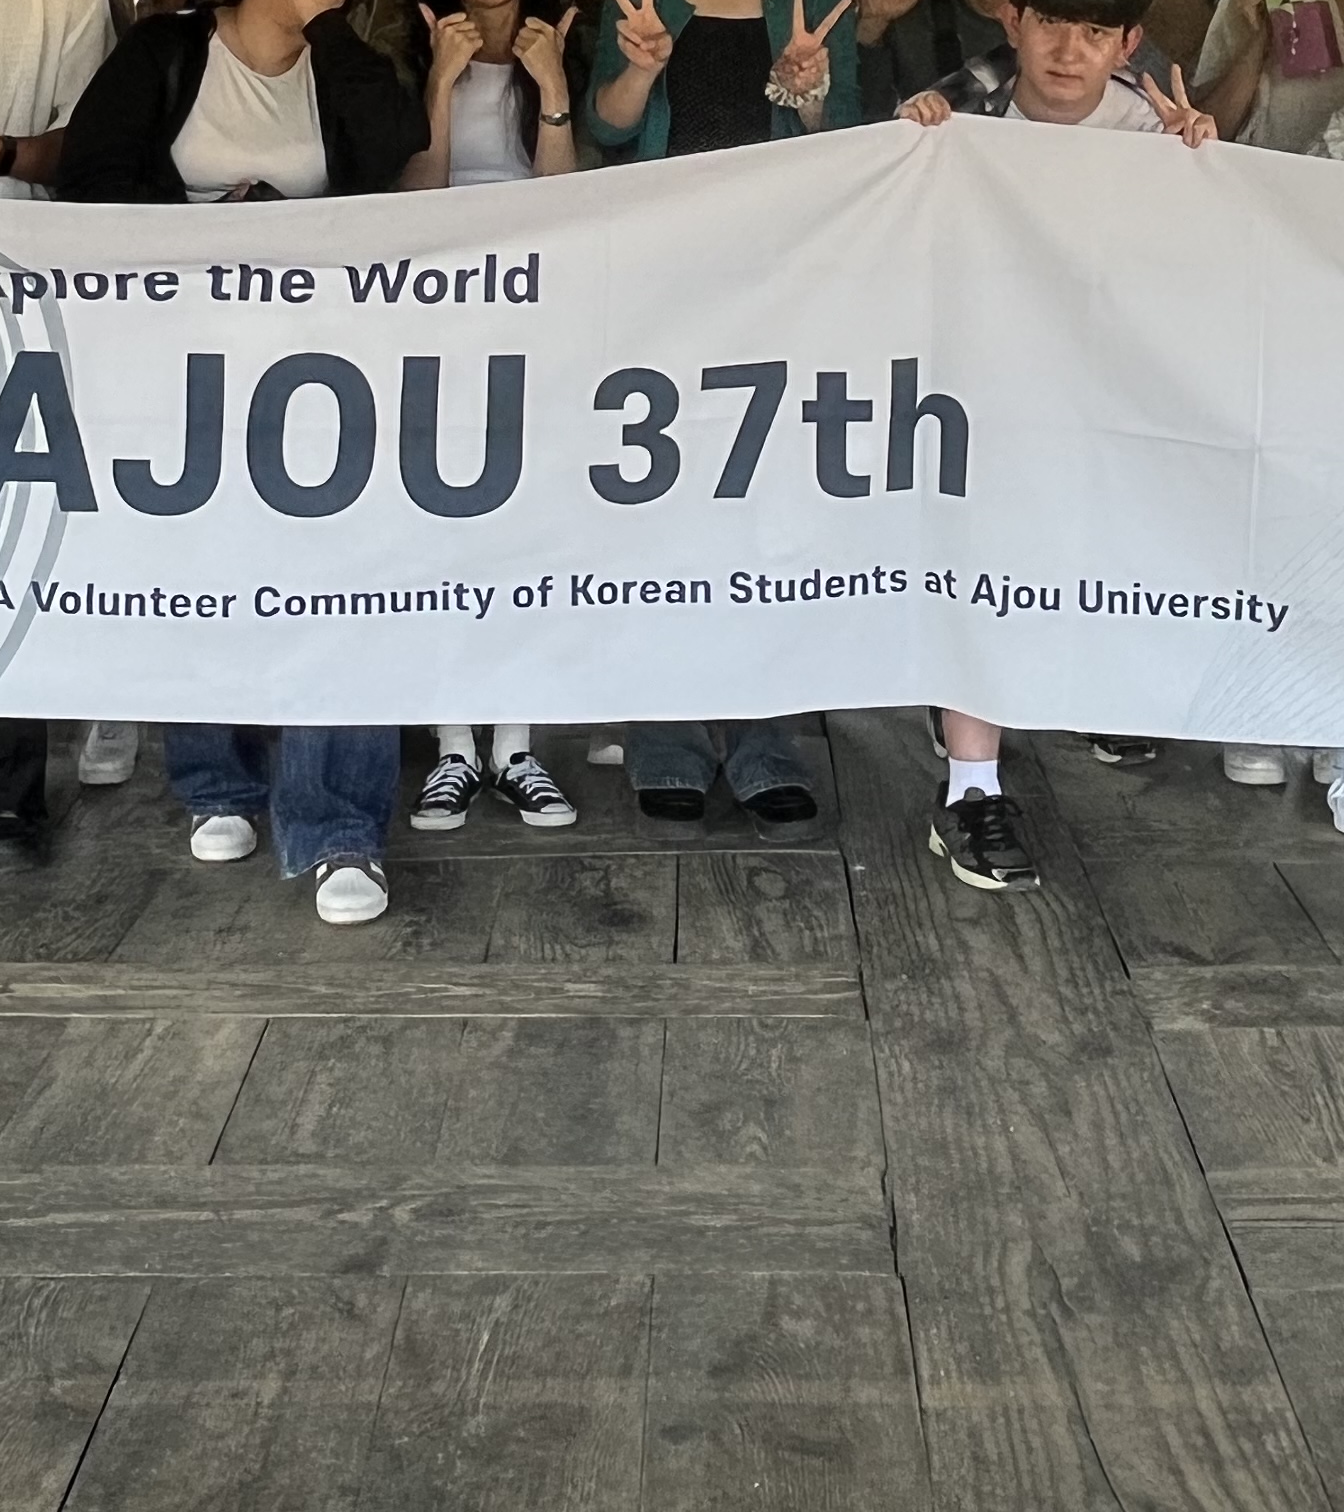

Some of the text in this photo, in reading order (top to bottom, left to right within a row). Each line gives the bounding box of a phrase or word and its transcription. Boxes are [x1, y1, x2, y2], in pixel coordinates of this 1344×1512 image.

[205, 263, 316, 304] the
[342, 252, 540, 305] World
[588, 357, 970, 505] 37th
[30, 580, 238, 619] Volunteer
[253, 583, 495, 620] Community
[512, 575, 555, 608] of
[571, 574, 712, 607] Korean
[729, 565, 908, 605] Students
[923, 569, 957, 600] at
[970, 573, 1062, 618] Ajou
[1079, 579, 1290, 633] University
